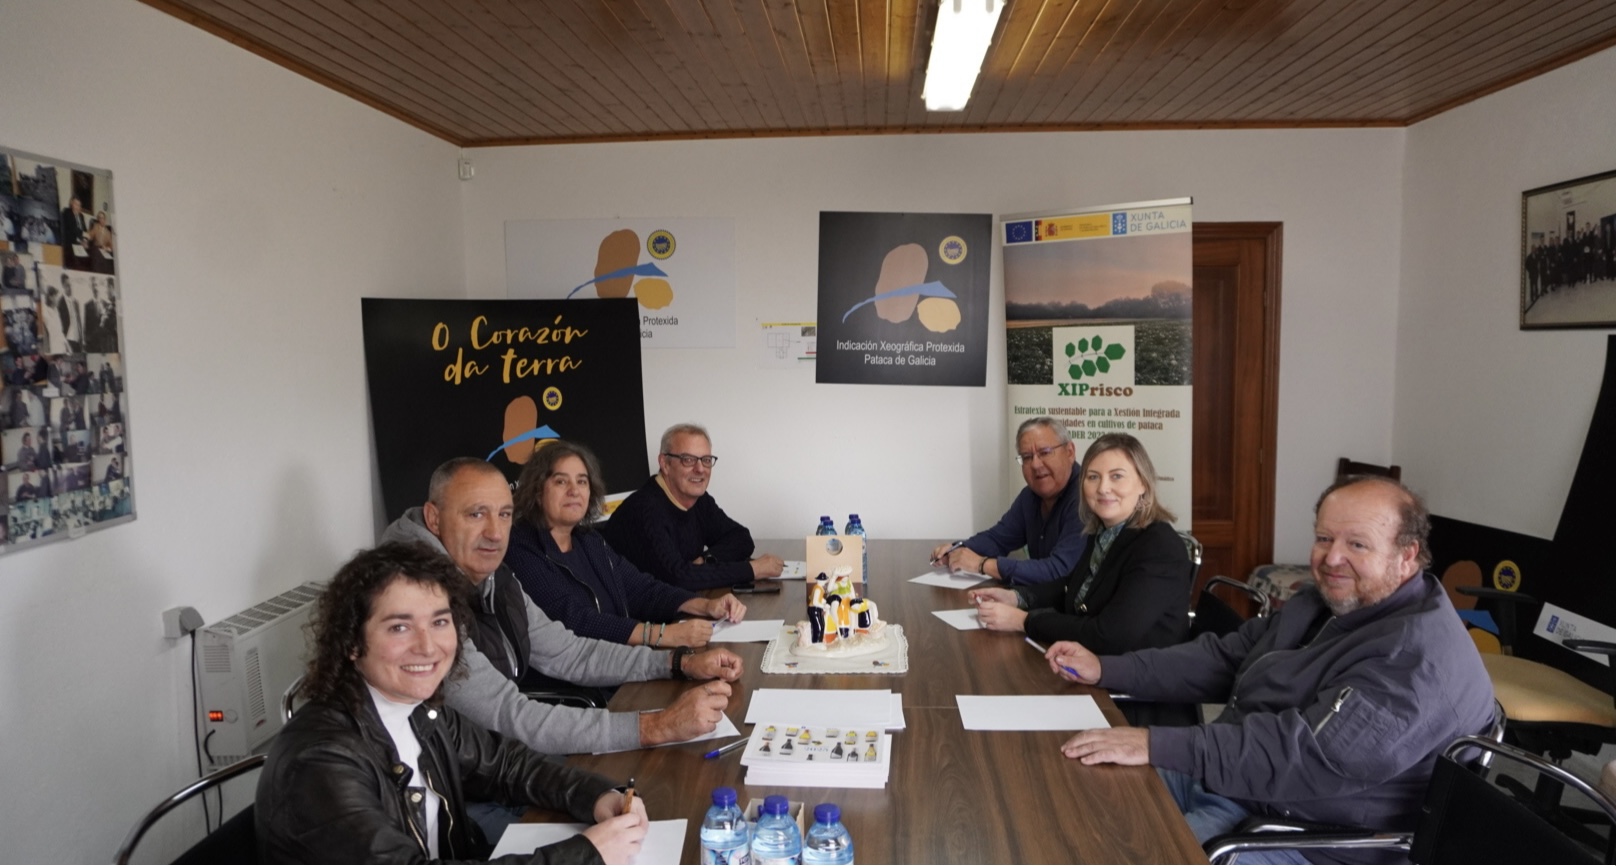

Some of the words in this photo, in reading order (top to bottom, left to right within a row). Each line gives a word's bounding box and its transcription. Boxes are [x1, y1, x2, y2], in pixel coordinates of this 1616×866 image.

[1130, 211, 1165, 221] XUNTA
[1130, 222, 1143, 232] DE
[1146, 219, 1187, 231] GALICIA
[643, 316, 678, 325] Protexida
[431, 322, 450, 351] O
[470, 315, 588, 350] Corazón
[836, 340, 878, 351] Indicación
[880, 340, 924, 353] Xeográfica
[926, 341, 965, 352] Protexida
[444, 347, 489, 385] da
[501, 348, 582, 384] terra
[864, 354, 893, 365] Pataca
[895, 355, 905, 365] de
[908, 355, 936, 365] Galicia
[1058, 383, 1133, 396] XIPrisco
[1014, 405, 1046, 415] Estratexia
[1048, 406, 1086, 416] sustentable
[1089, 408, 1105, 418] para
[1114, 407, 1140, 417] Xestión
[1142, 408, 1180, 419] Integrada
[1062, 418, 1085, 428] idades
[1087, 420, 1096, 428] en
[1098, 420, 1125, 429] cultivos
[1127, 420, 1136, 429] de
[1138, 422, 1163, 431] pataca
[1068, 430, 1085, 439] ADER
